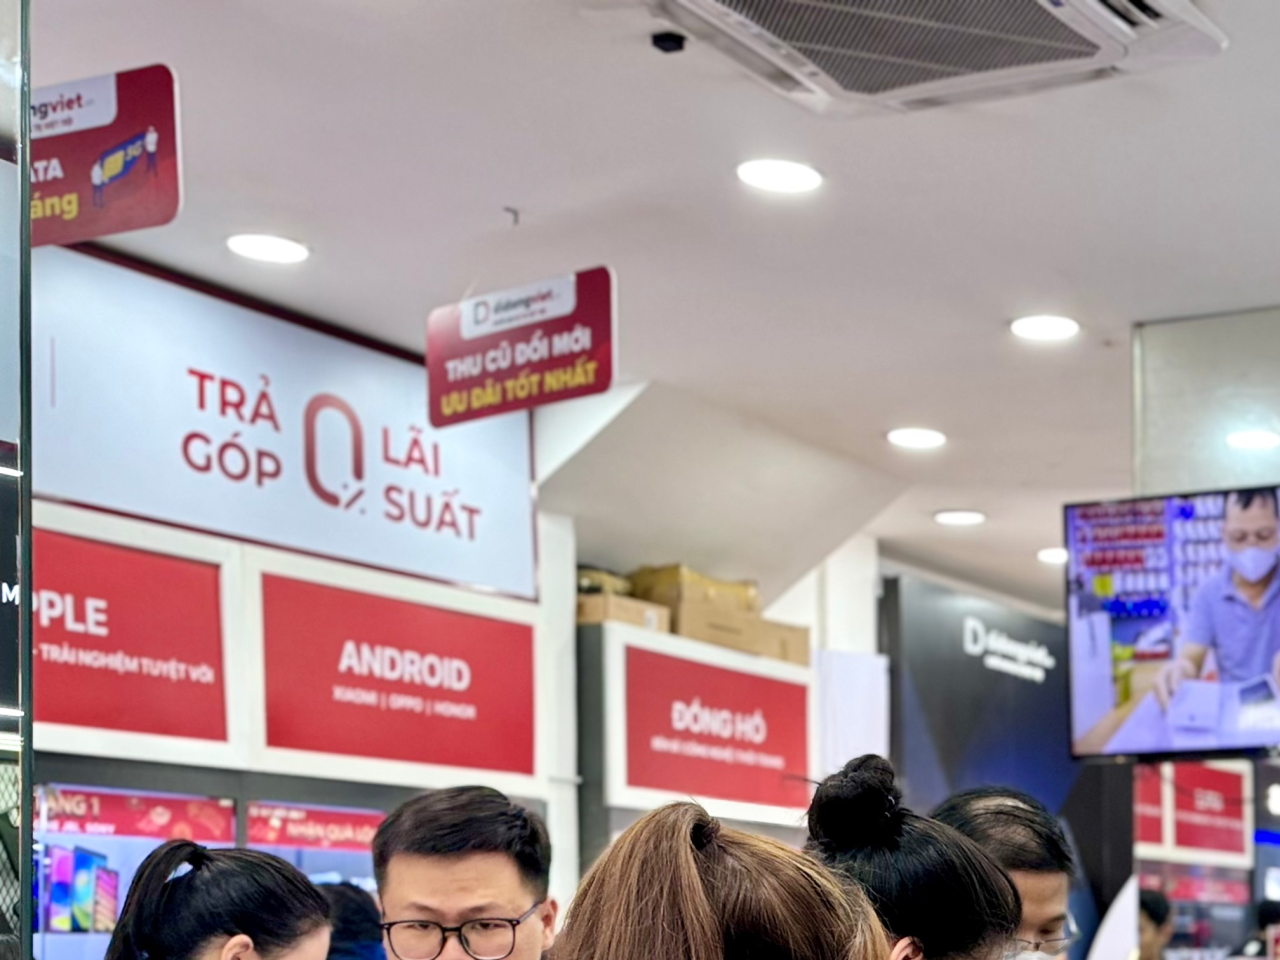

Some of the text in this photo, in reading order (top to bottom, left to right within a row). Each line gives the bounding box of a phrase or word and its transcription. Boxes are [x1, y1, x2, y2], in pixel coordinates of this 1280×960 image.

[444, 353, 482, 382] THU
[187, 367, 281, 432] TRẢ
[181, 432, 282, 488] GÓP
[382, 424, 440, 478] LÃI
[384, 484, 482, 542] SUẤT
[32, 588, 109, 637] PLE
[338, 639, 472, 692] ANDROID
